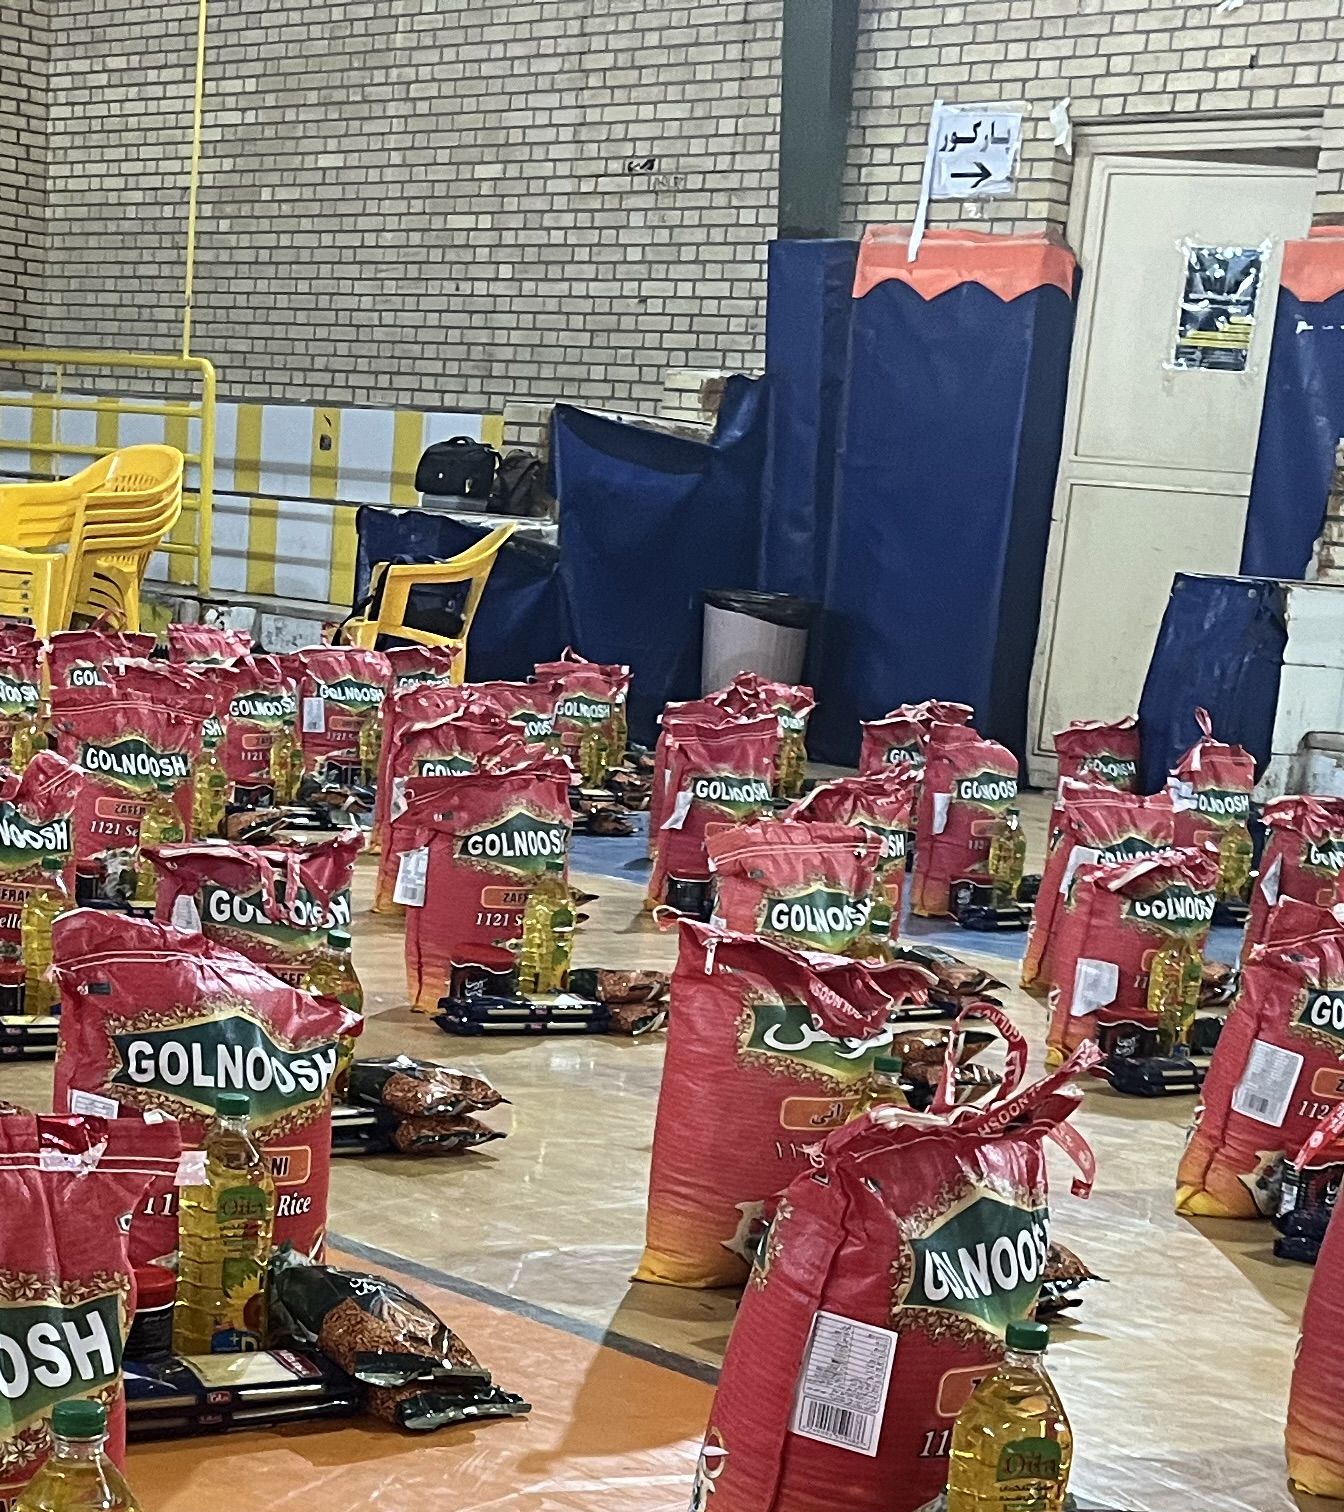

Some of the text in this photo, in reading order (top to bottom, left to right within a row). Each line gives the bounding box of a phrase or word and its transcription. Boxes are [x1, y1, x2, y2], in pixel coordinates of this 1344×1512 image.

[86, 746, 186, 777] GOLNOOSH
[127, 1041, 337, 1093] GOLNOOSH
[277, 1191, 311, 1216] Rice
